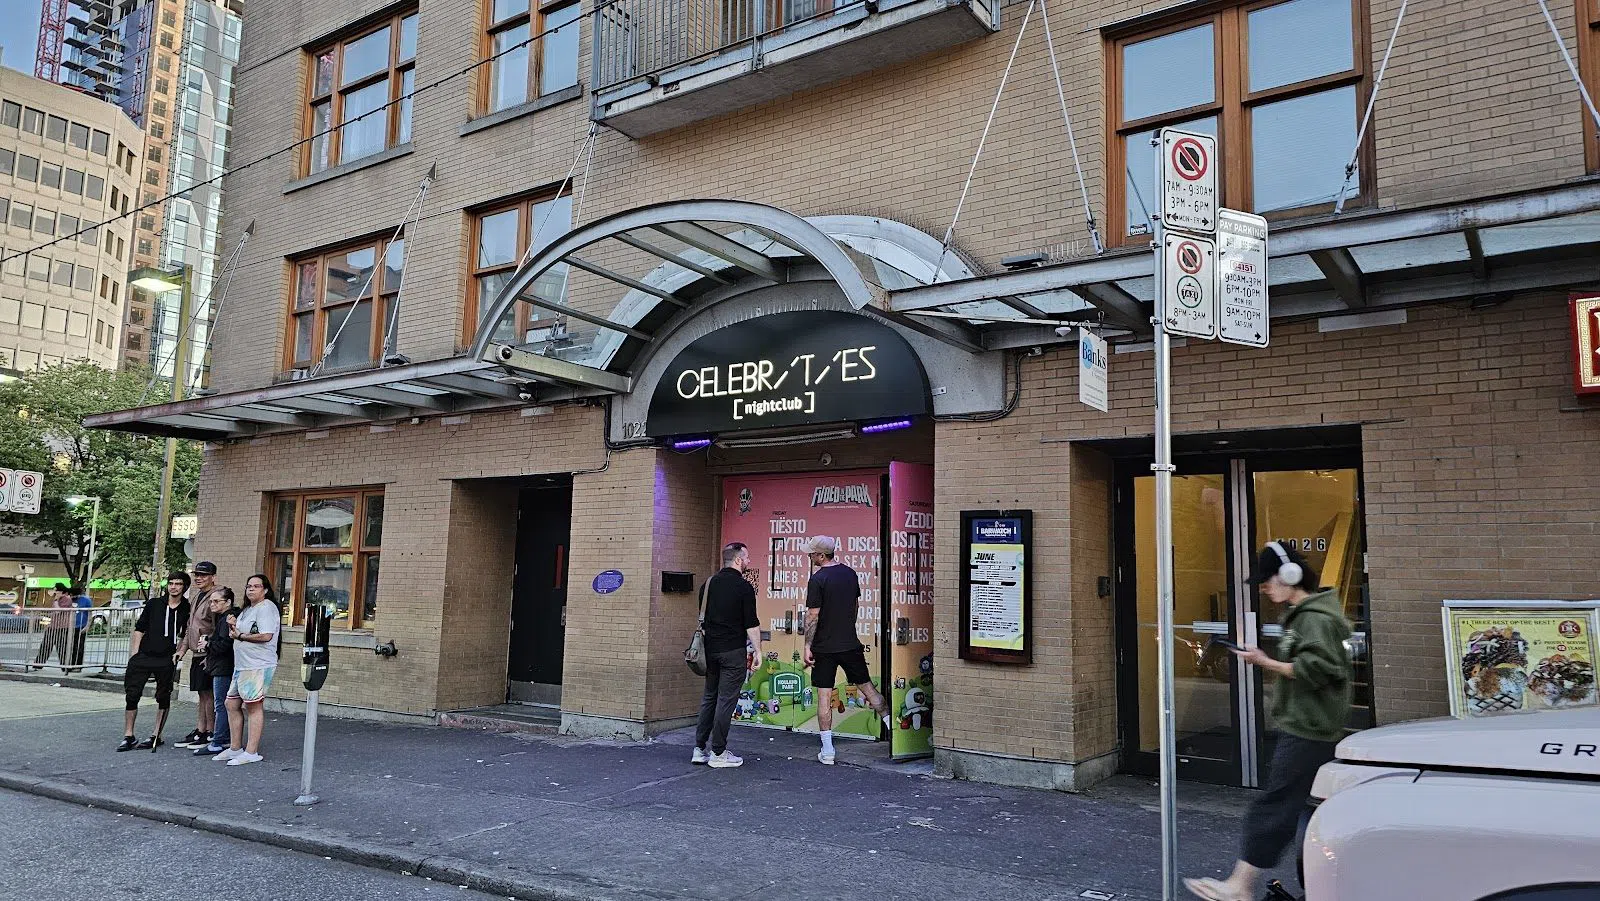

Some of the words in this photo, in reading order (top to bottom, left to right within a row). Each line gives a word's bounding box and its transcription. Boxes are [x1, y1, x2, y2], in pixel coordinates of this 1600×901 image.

[1167, 181, 1180, 192] 7AM
[1171, 196, 1185, 208] 3PM
[1194, 200, 1209, 212] 6PM
[1220, 219, 1233, 230] PAY
[1234, 223, 1266, 239] PARKING
[1174, 307, 1187, 317] 8PM
[1193, 310, 1206, 320] 3AM
[1082, 341, 1106, 369] Banks
[770, 517, 806, 534] TIËSTO
[904, 511, 933, 529] ZEDD
[844, 554, 866, 569] SEX
[974, 552, 996, 561] JUNE
[766, 586, 807, 599] SAMMY
